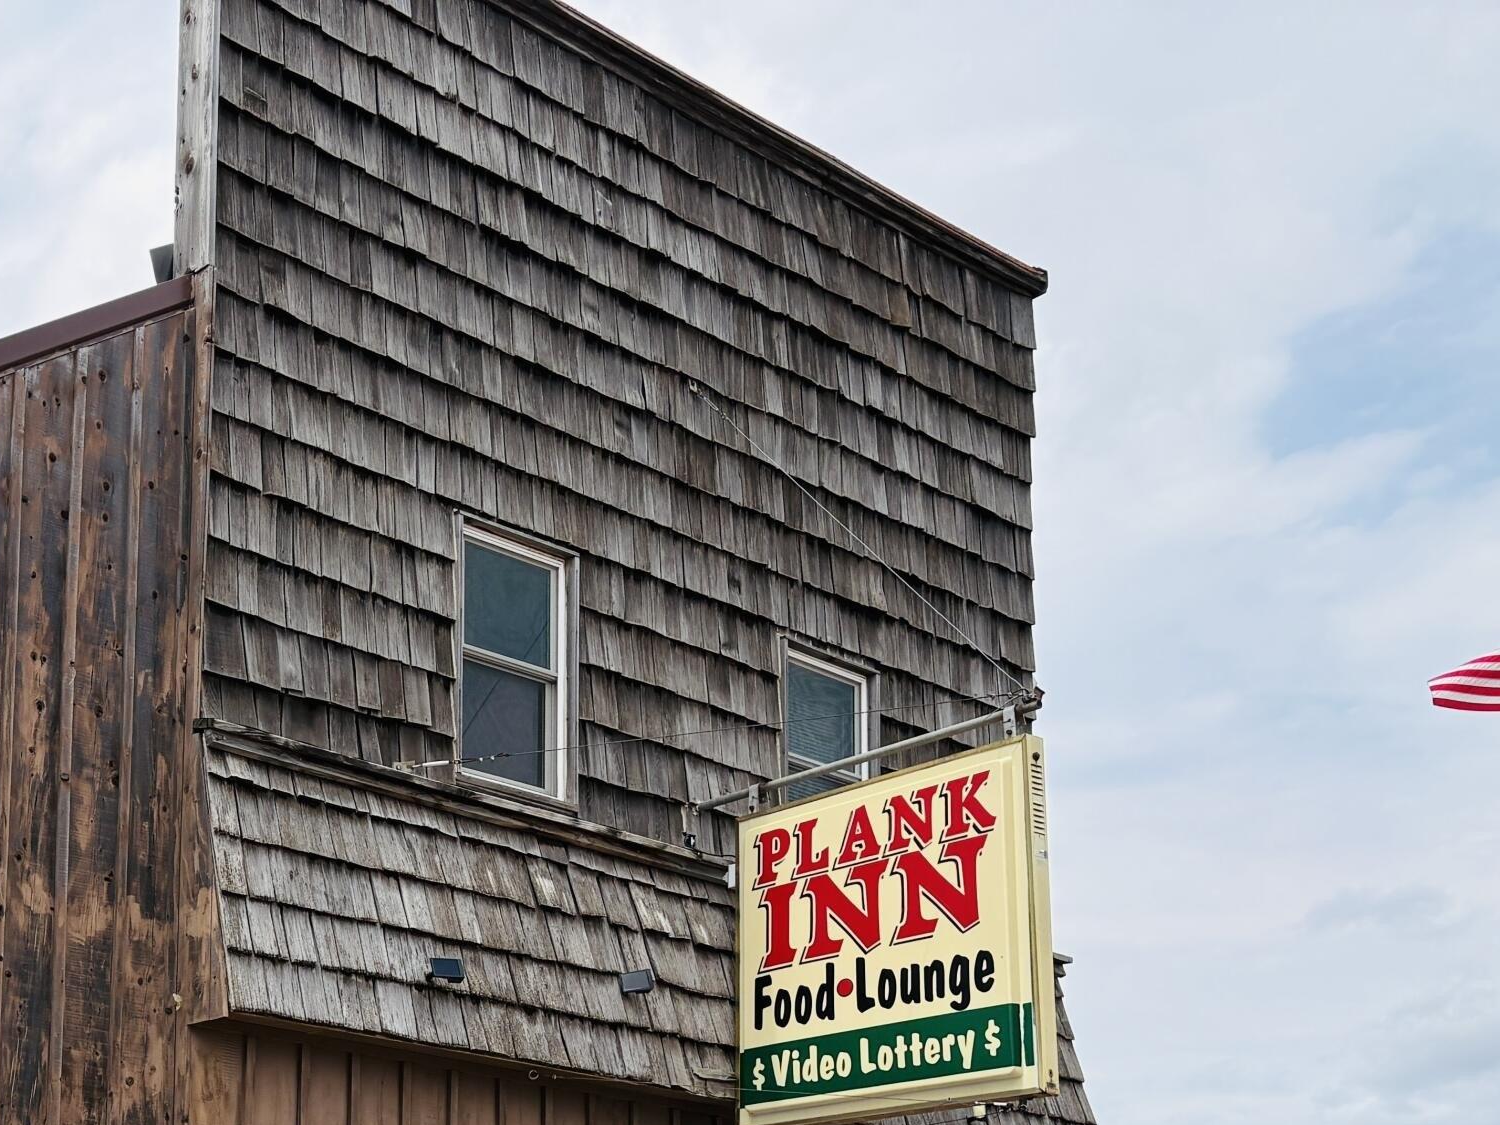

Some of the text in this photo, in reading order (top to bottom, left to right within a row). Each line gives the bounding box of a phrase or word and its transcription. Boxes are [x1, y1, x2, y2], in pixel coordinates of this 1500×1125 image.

[753, 770, 997, 890] PLANK
[758, 834, 989, 973] INN
[754, 950, 995, 1030] Food Lounge
[771, 1046, 851, 1088] Video
[860, 1029, 976, 1075] Lottery
